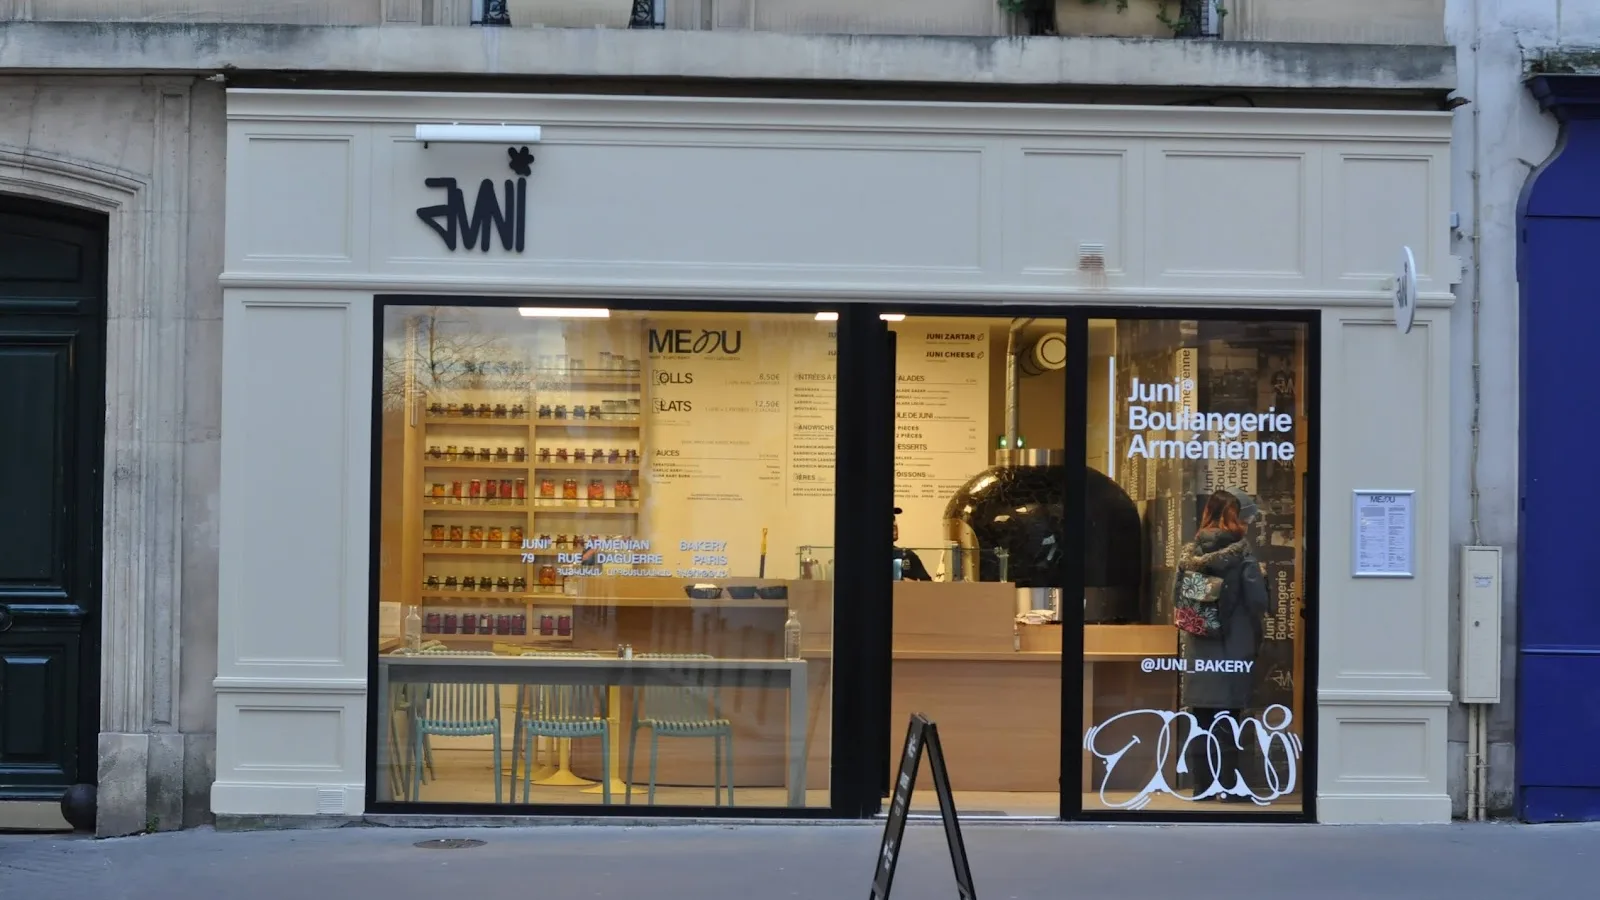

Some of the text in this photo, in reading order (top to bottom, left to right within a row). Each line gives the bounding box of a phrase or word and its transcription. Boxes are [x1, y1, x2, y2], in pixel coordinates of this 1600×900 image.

[1127, 405, 1293, 438] Boulangerie
[1126, 433, 1296, 461] Arménienne
[585, 539, 650, 550] ARMENIAN
[679, 540, 727, 551] BAKERY
[521, 552, 728, 565] 79 RUE DAGUERRE PARIS
[1275, 570, 1289, 640] Boulangerie
[1140, 657, 1254, 674] @JUNI_BAKERY
